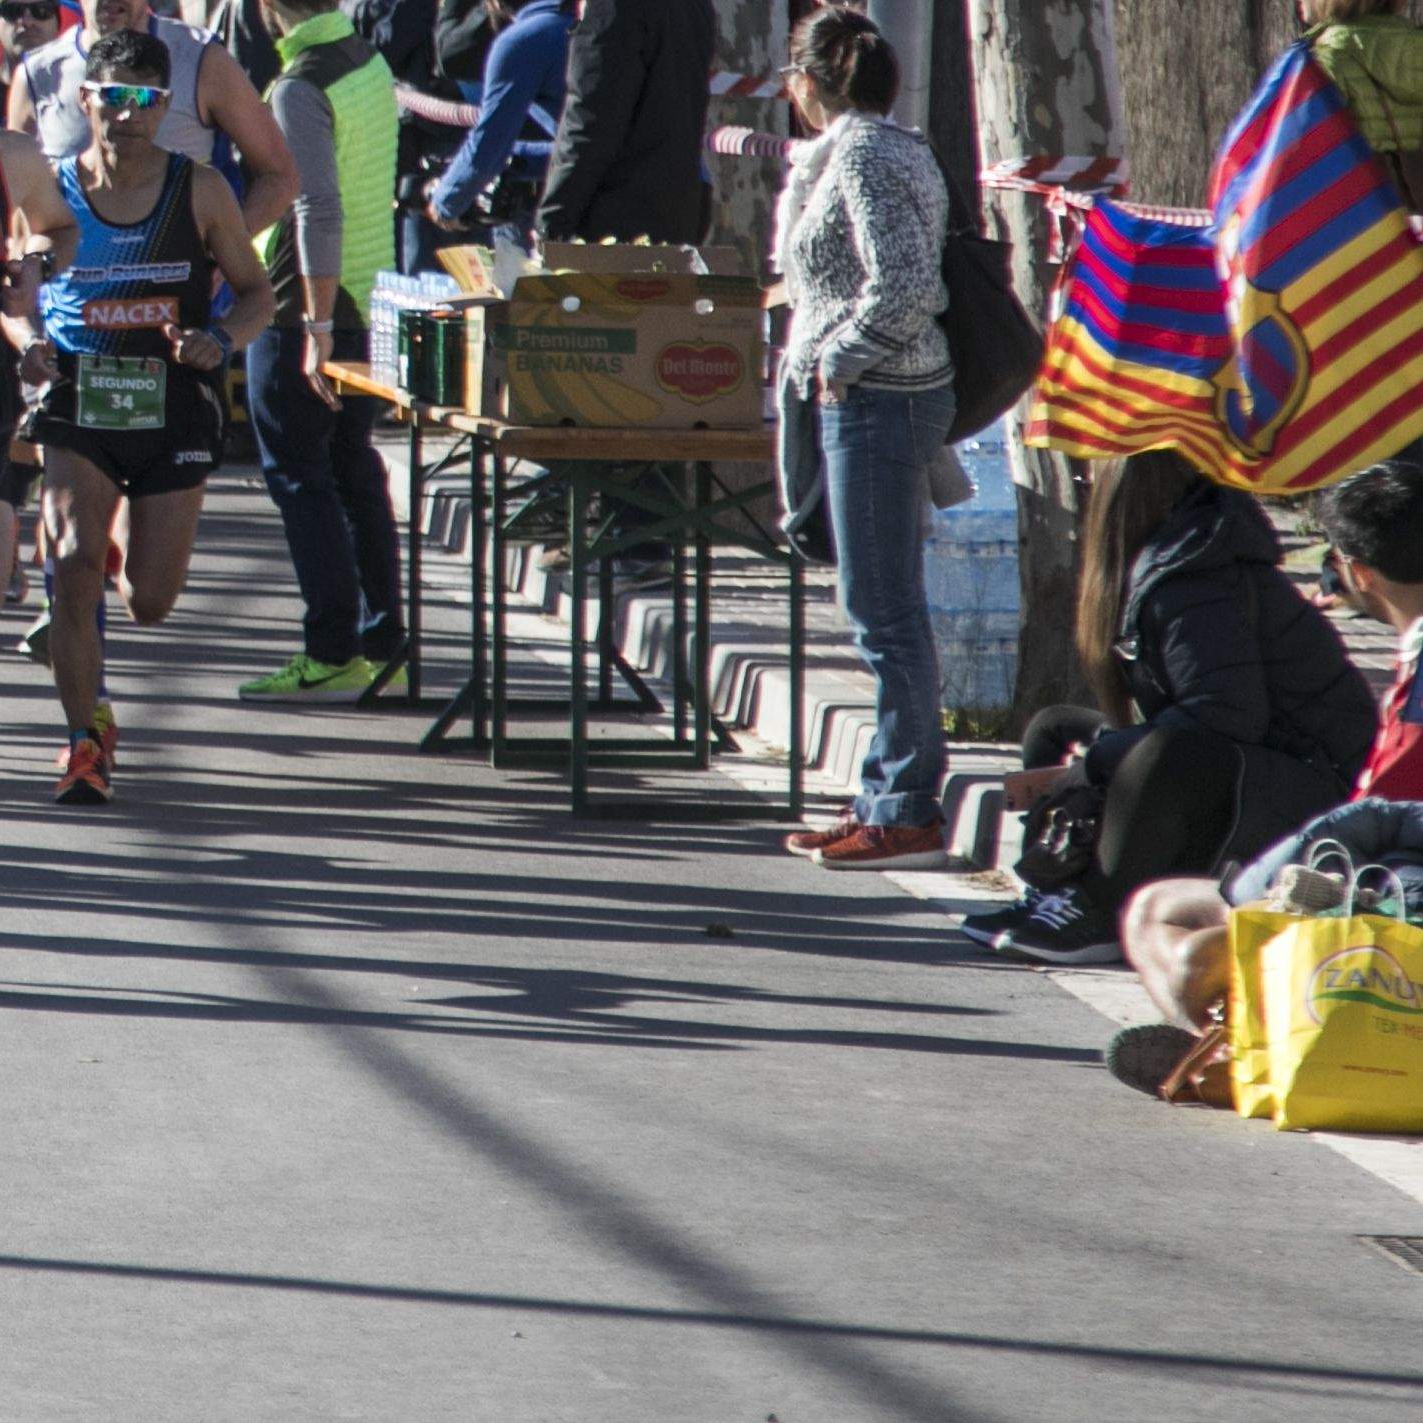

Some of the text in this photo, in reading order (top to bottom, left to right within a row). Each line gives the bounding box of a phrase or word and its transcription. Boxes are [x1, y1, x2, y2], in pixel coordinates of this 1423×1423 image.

[89, 303, 174, 325] NACEX
[516, 330, 608, 349] Premium
[516, 354, 624, 373] BANANAS
[662, 359, 738, 374] Del Monte
[90, 377, 157, 391] SEGUNDO
[112, 394, 134, 410] 34
[1324, 966, 1423, 1001] ZANU
